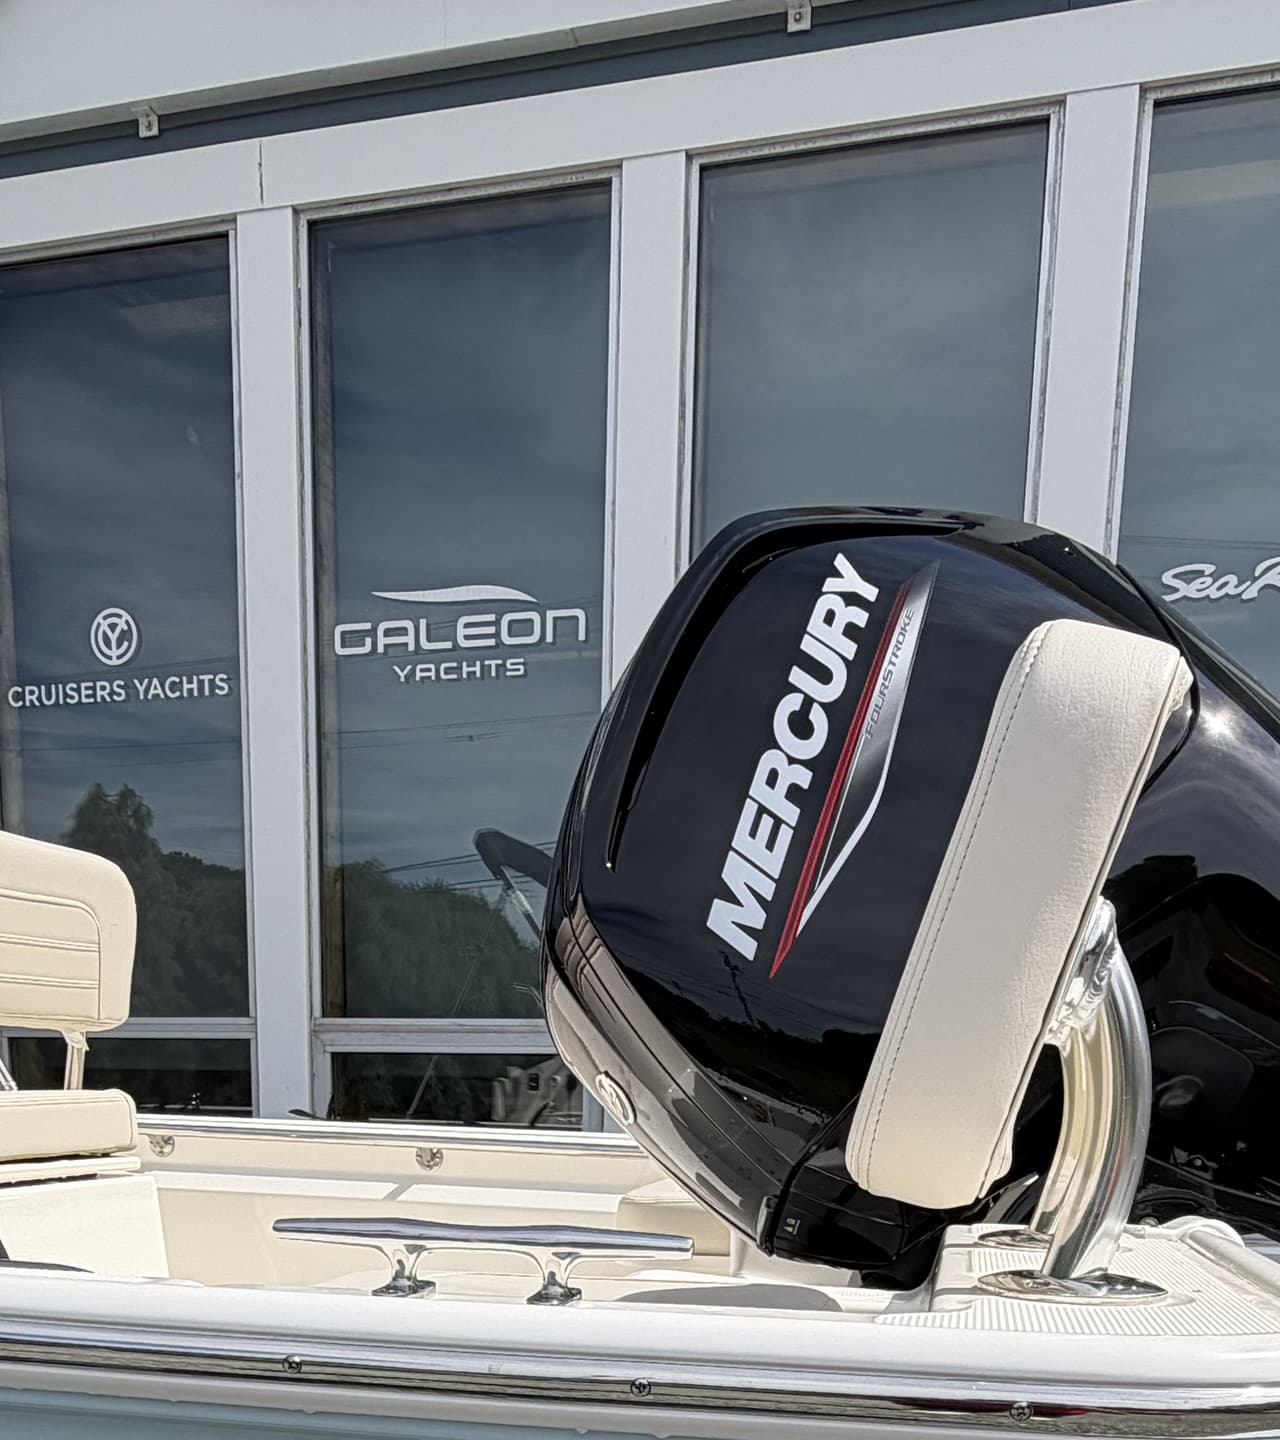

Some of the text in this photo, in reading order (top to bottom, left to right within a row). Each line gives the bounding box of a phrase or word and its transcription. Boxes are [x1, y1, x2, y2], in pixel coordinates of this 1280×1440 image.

[1161, 562, 1251, 602] Sea
[334, 607, 587, 656] GALEON
[7, 673, 229, 708] CRUISERS YACHTS
[392, 657, 525, 682] YACHTS
[865, 607, 915, 739] FOURSTROKE
[706, 553, 880, 961] MERCURY
